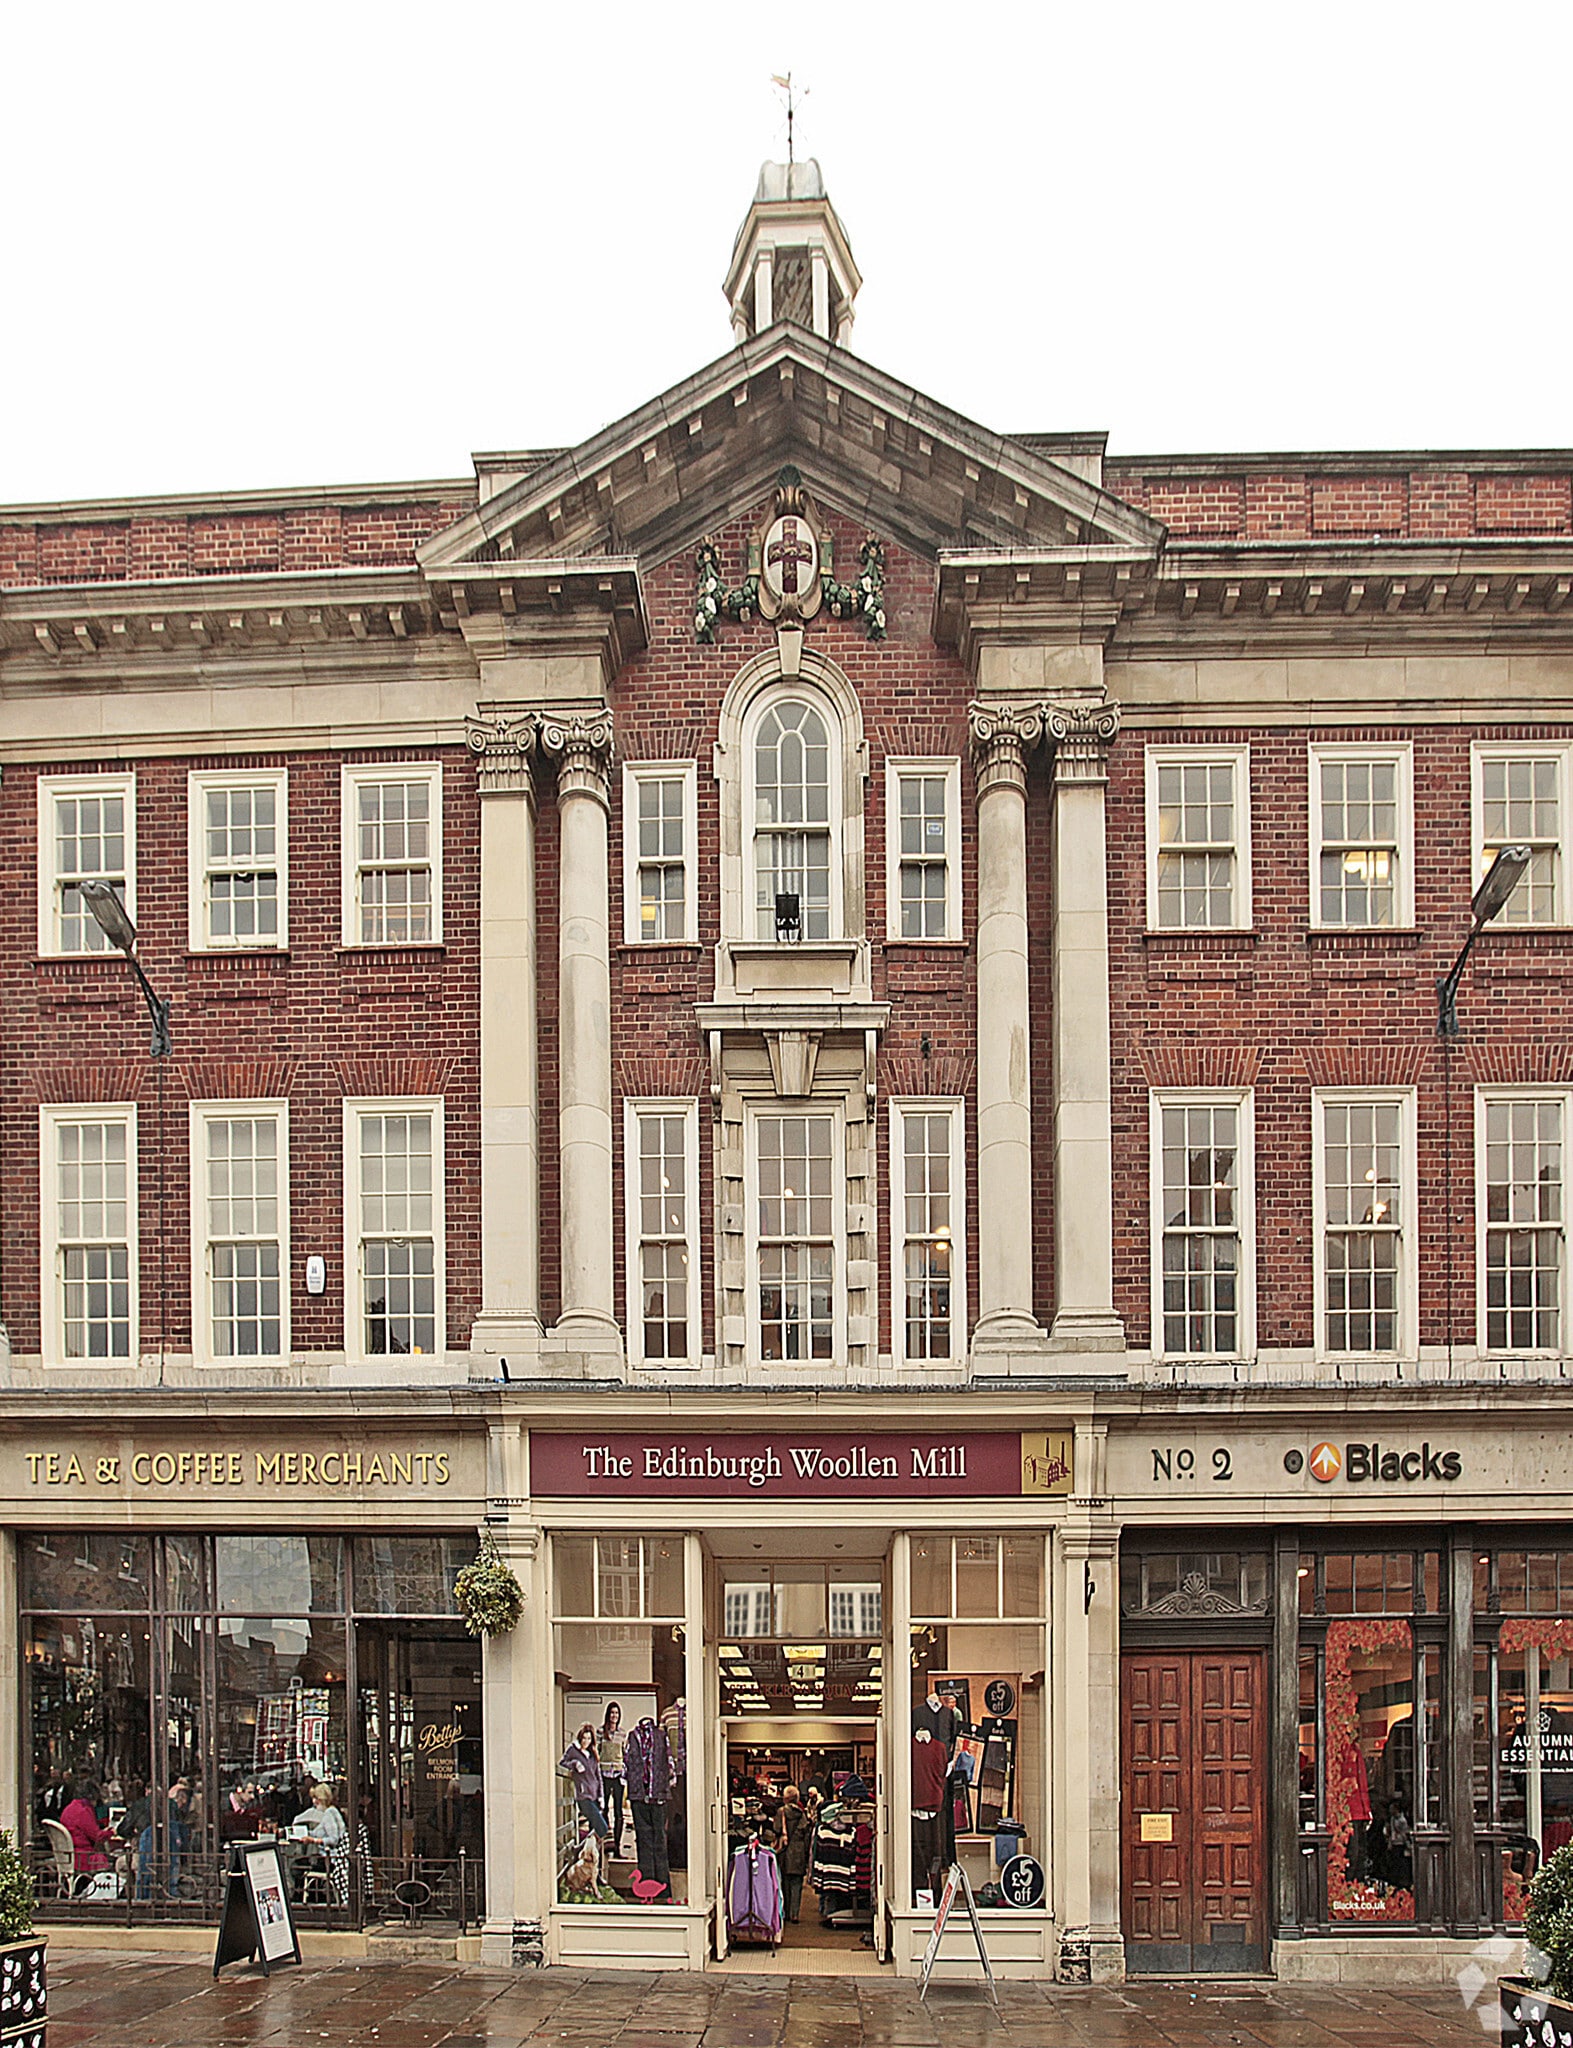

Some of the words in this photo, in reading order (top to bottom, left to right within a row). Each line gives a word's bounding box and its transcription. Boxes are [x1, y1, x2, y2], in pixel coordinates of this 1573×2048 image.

[25, 1453, 86, 1484] TEA
[95, 1457, 120, 1484] &
[131, 1452, 242, 1484] COFFEE
[255, 1453, 450, 1484] MERCHANTS
[582, 1446, 633, 1477] The
[642, 1446, 783, 1486] Edinburgh
[789, 1446, 899, 1478] Woollen
[910, 1446, 967, 1478] Mill
[1212, 1448, 1233, 1481] 2
[1345, 1442, 1462, 1482] Blacks
[796, 1665, 804, 1678] 4
[991, 1682, 1006, 1701] £5
[992, 1701, 1004, 1711] off
[418, 1724, 464, 1753] Bettys
[1513, 1734, 1573, 1747] AUTUMN
[426, 1772, 460, 1780] ENTRANCE
[1011, 1859, 1034, 1887] £5
[1014, 1887, 1031, 1902] off
[1333, 1900, 1386, 1910] Blacks.co.uk
